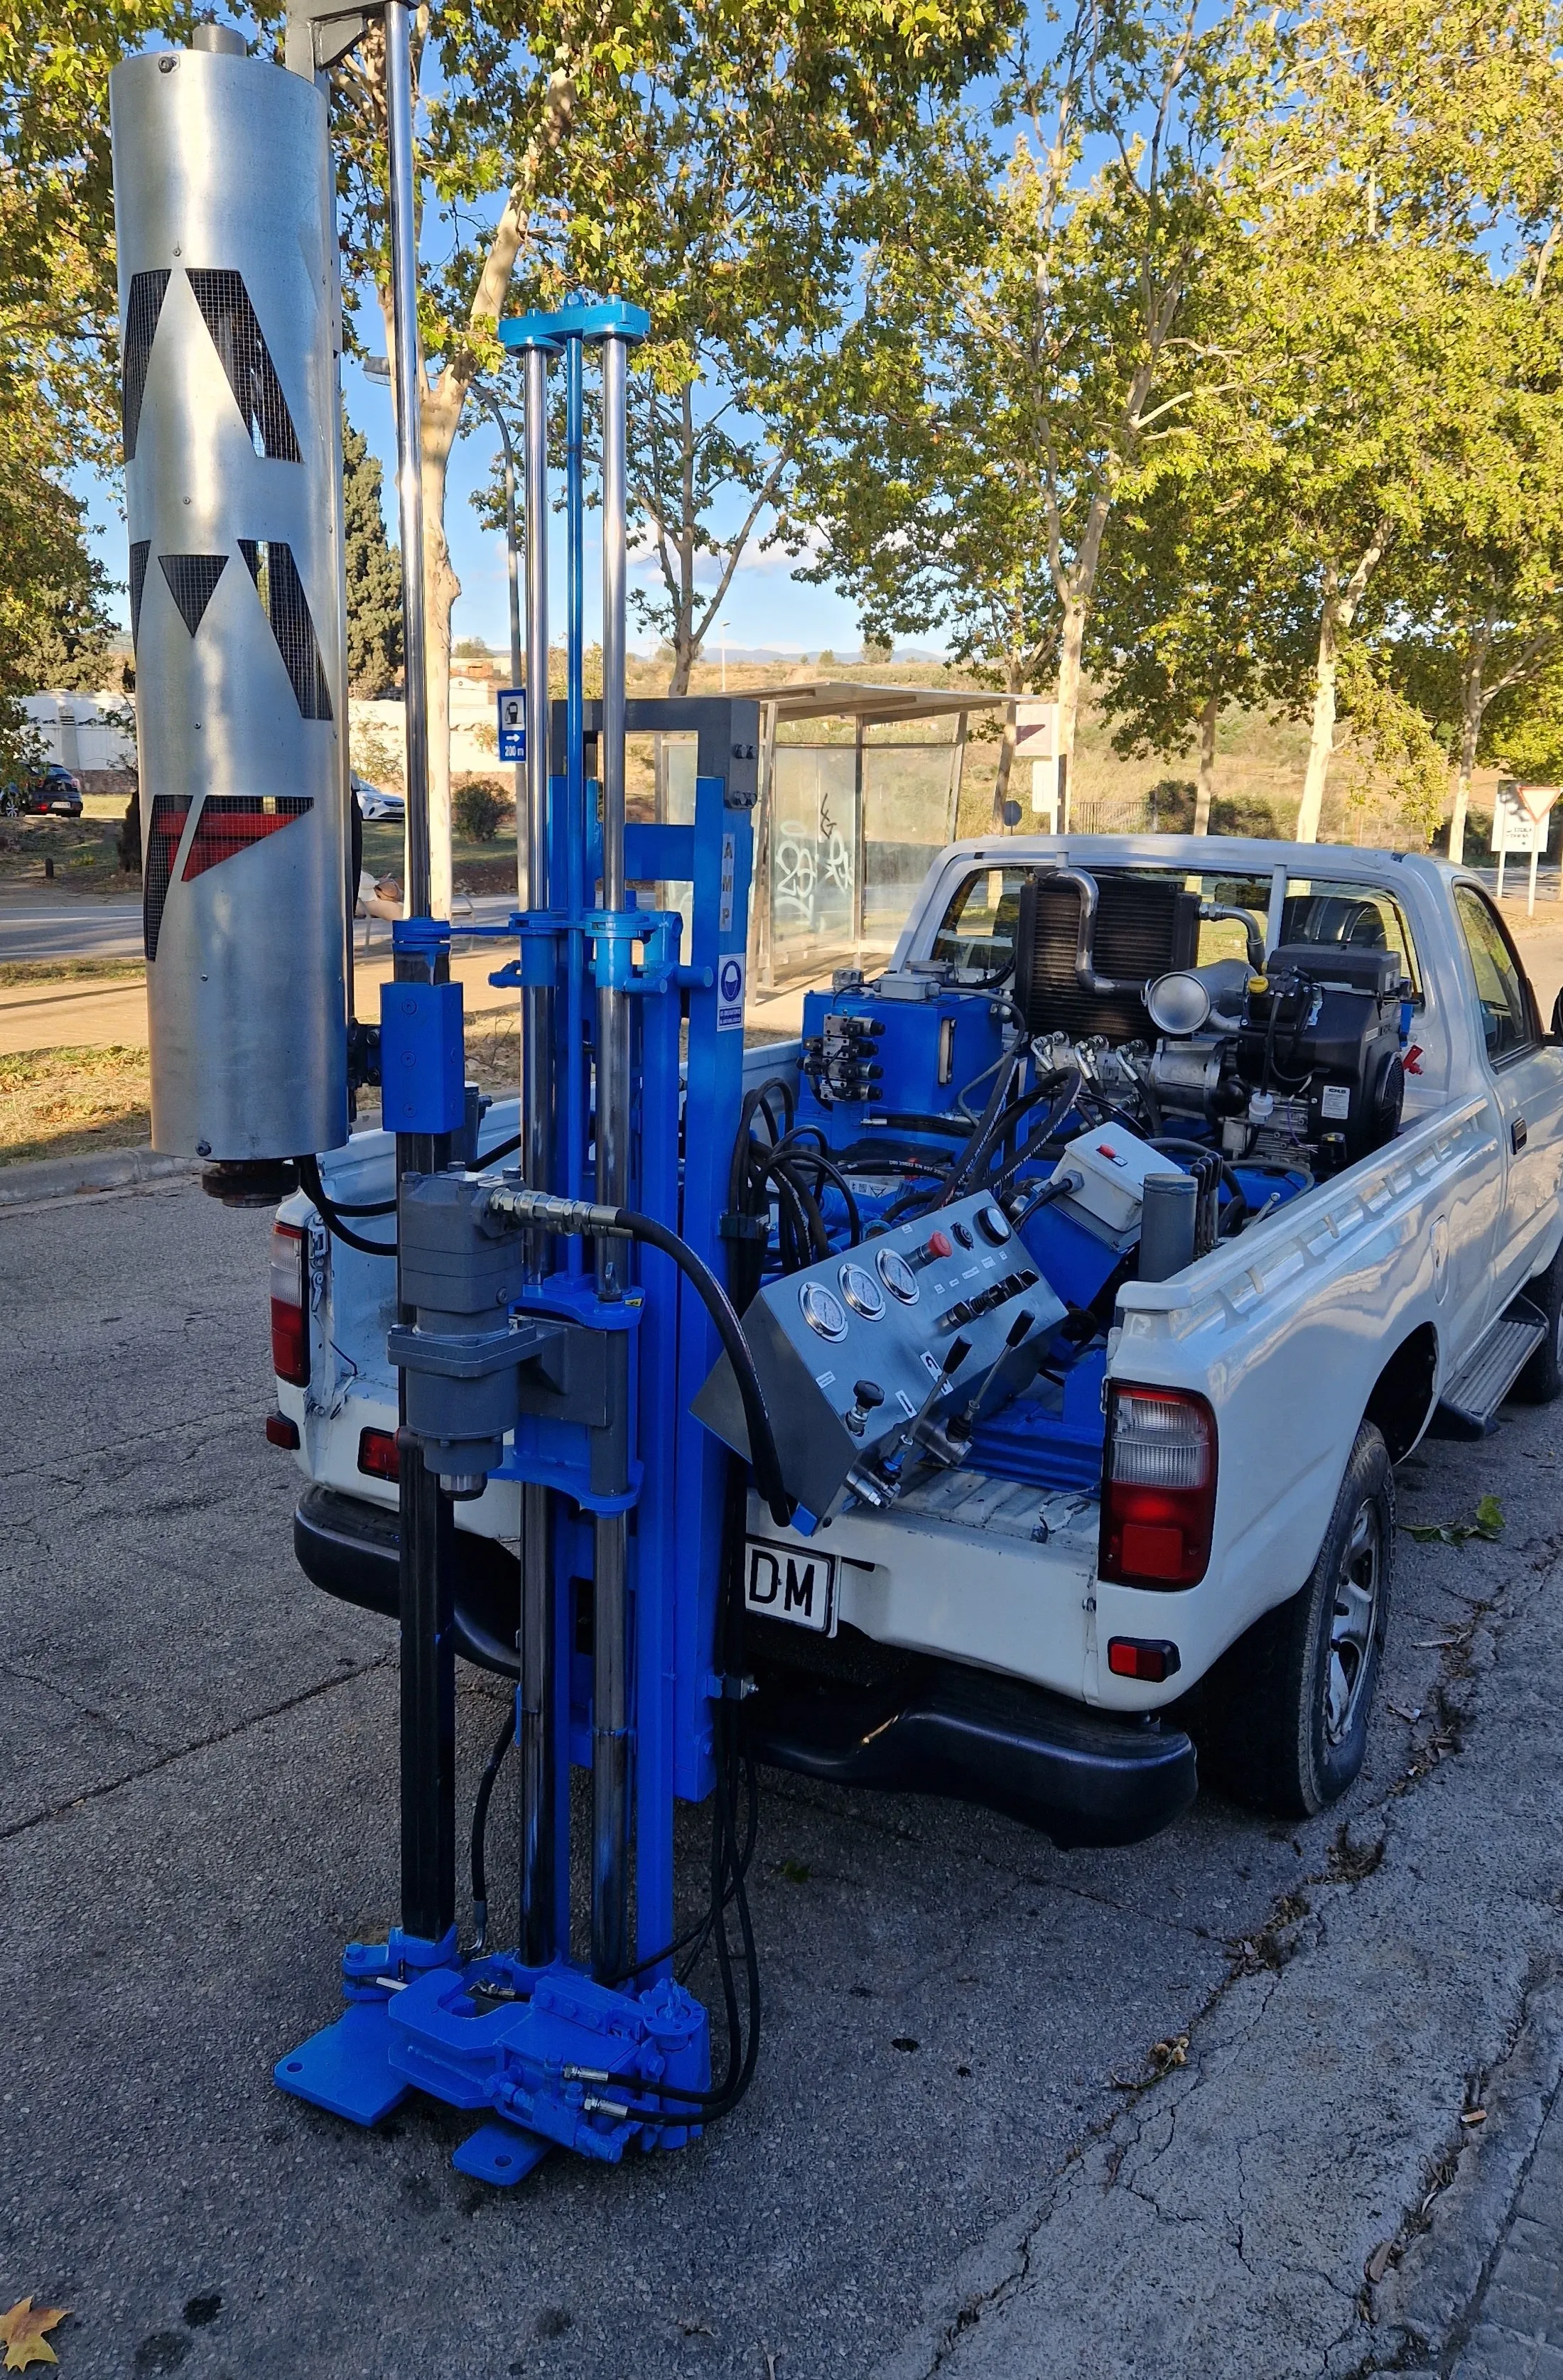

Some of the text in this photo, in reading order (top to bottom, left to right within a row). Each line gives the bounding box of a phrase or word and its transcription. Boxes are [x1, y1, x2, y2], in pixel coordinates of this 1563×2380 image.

[505, 745, 524, 757] 200 m
[749, 1549, 815, 1617] DM
